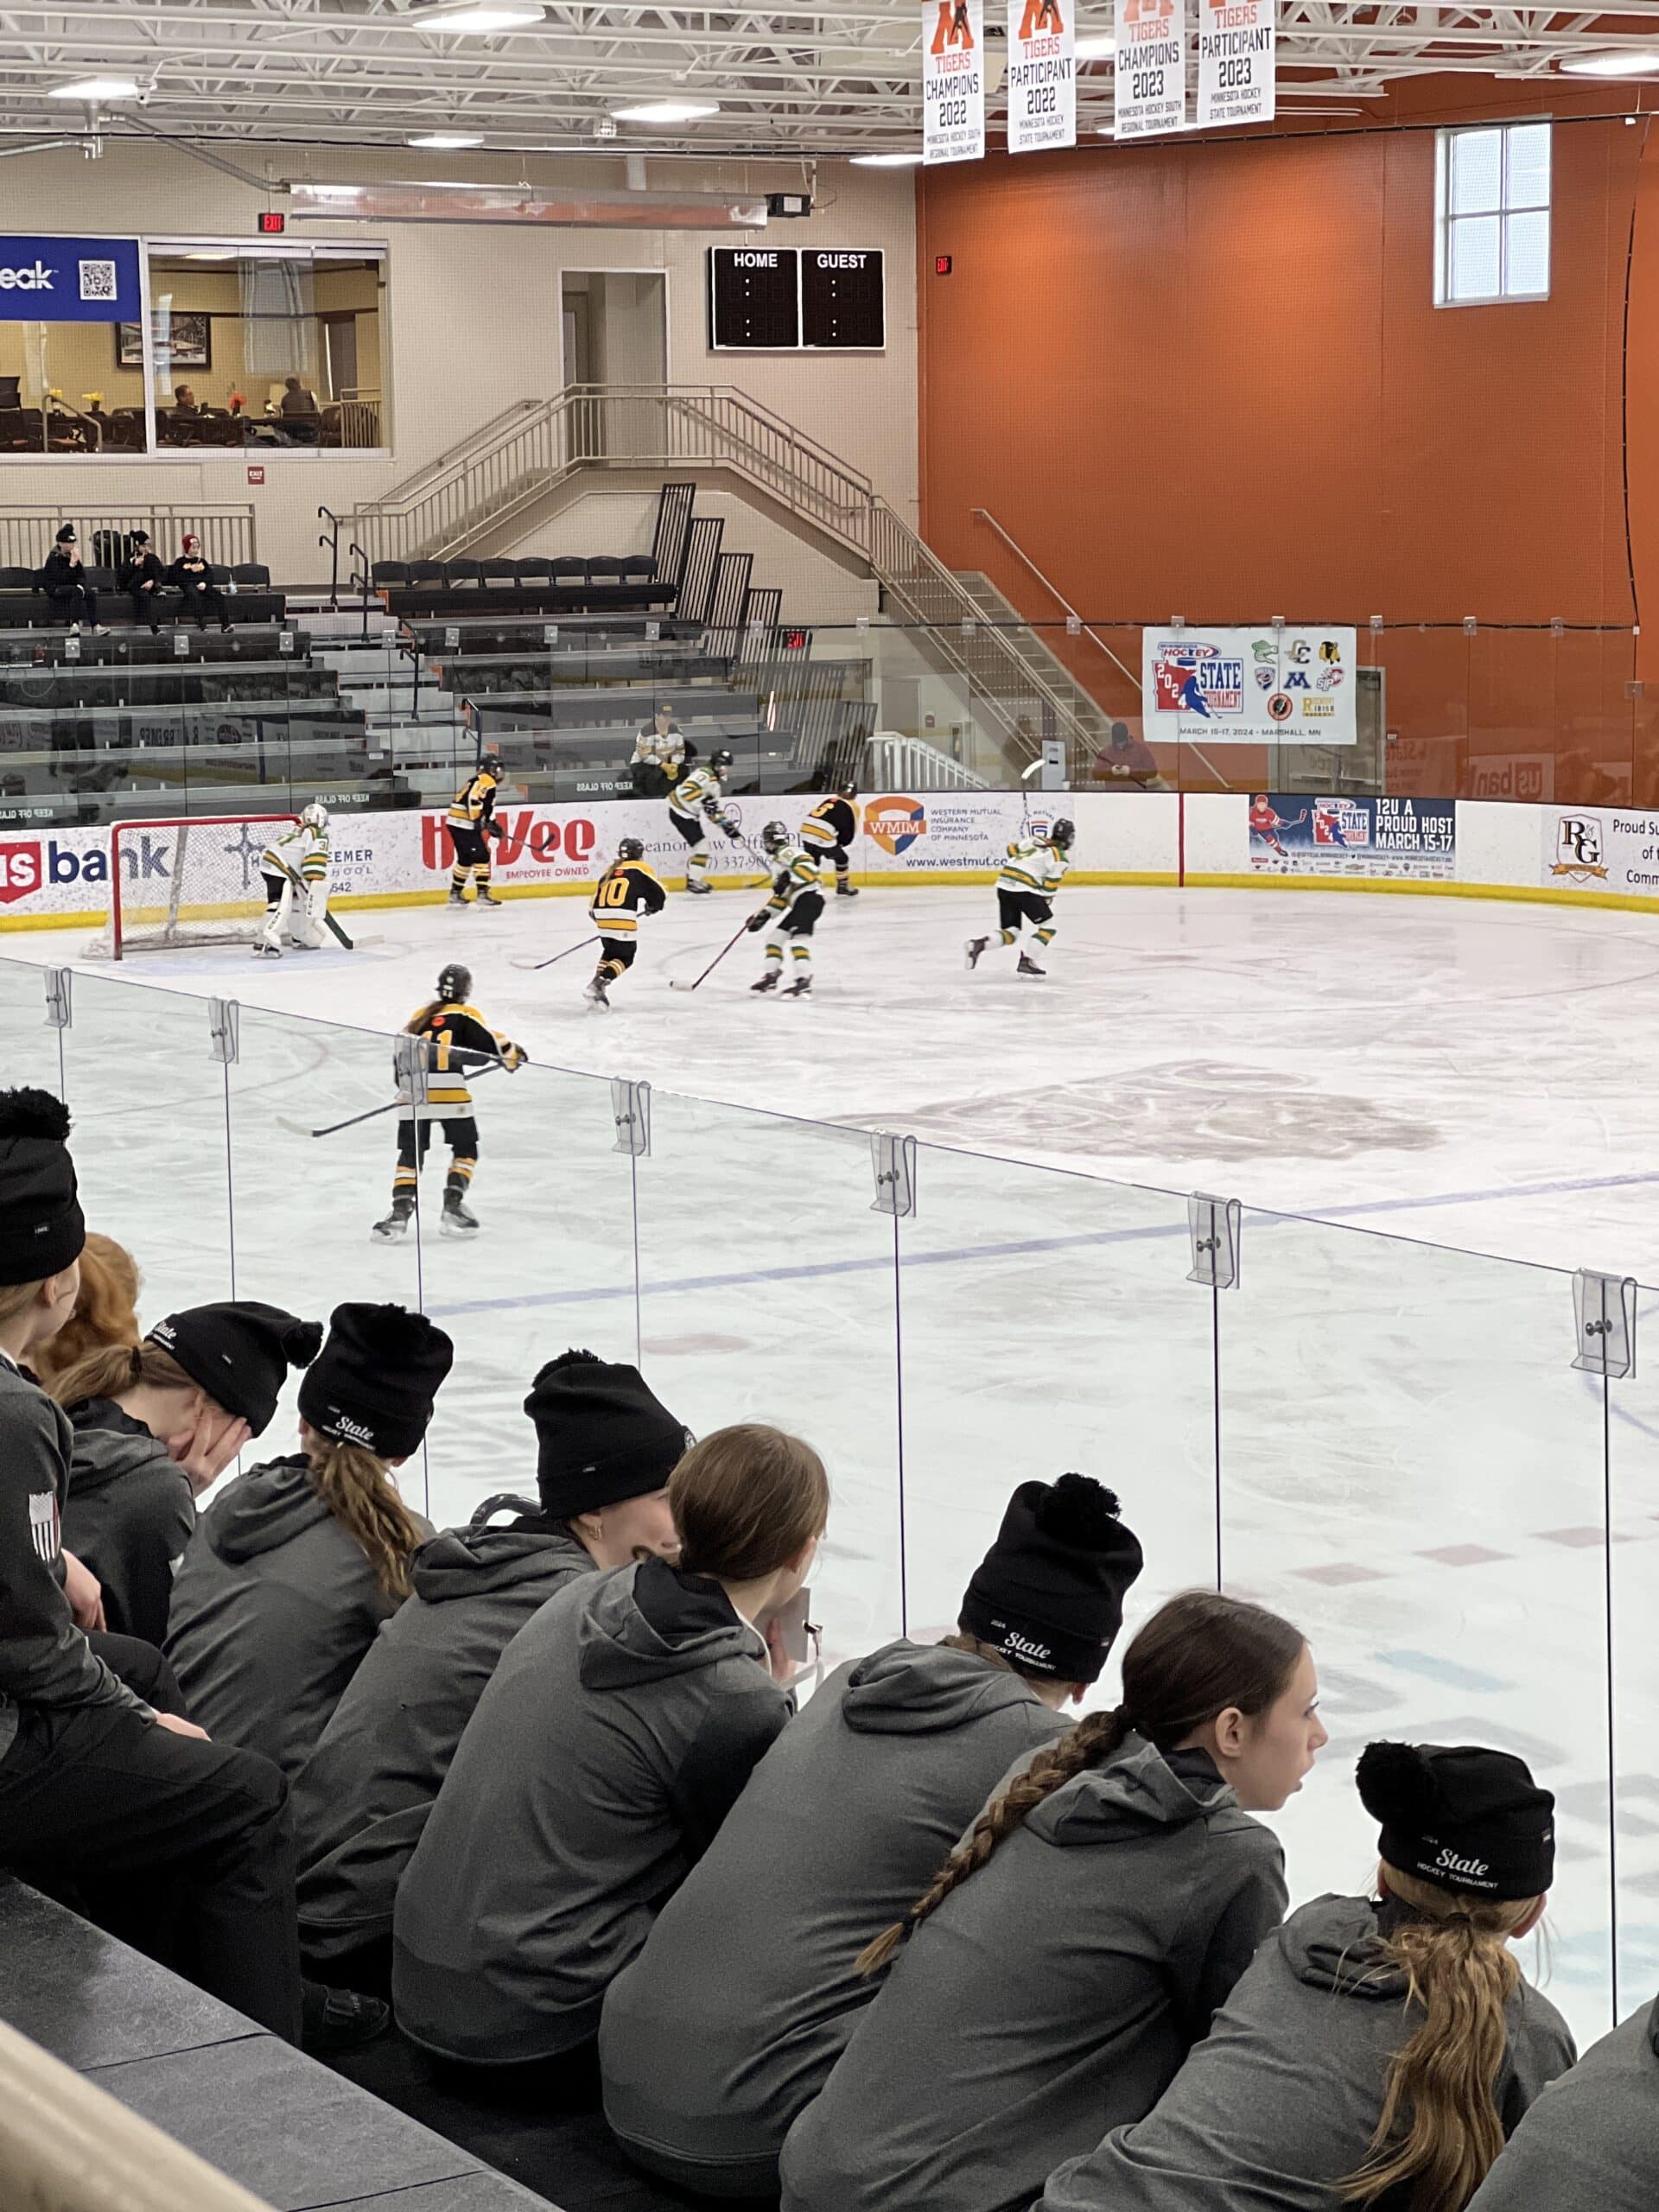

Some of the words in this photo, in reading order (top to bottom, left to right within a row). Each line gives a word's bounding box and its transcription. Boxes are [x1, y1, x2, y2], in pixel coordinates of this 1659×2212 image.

[1214, 4, 1257, 29] TIGERS
[1128, 18, 1169, 42] TIGERS
[1023, 36, 1060, 60] TIGERS
[1202, 28, 1271, 59] PARTICIPANT
[935, 52, 970, 73] TIGERS
[1119, 41, 1179, 71] CHAMPIONS
[1011, 58, 1071, 88] PARTICIPANT
[1133, 69, 1164, 99] 2023
[1218, 57, 1251, 88] 2023
[926, 73, 978, 100] CHAMPIONS
[1211, 90, 1239, 104] MINNESOTA
[1241, 87, 1262, 99] HOCKEY
[1027, 86, 1055, 114] 2022
[1118, 105, 1143, 118] MINNESOTA
[1145, 102, 1164, 115] HOCKEY
[1166, 99, 1182, 112] SOUTH
[1210, 107, 1225, 119] STATE
[1227, 103, 1262, 118] TOURNAMENT
[939, 99, 967, 127] 2022
[734, 253, 778, 267] HOME
[817, 254, 867, 268] GUEST
[1200, 663, 1241, 689] STATE
[1376, 798, 1399, 815] 12U
[1404, 799, 1414, 815] A
[870, 822, 919, 834] WMIM
[1342, 812, 1367, 830] STATE
[1376, 816, 1417, 832] PROUD
[1421, 817, 1453, 834] HOST
[1613, 819, 1645, 835] Proud
[1376, 832, 1420, 850] MARCH
[1423, 835, 1453, 851] 15-17
[1643, 846, 1654, 860] of
[48, 836, 170, 884] bank
[505, 868, 551, 880] EMPLOYEE
[555, 867, 589, 877] OWNED
[599, 877, 630, 906] 10
[335, 1416, 374, 1440] State
[1004, 1631, 1051, 1659] State
[1436, 1848, 1489, 1876] State
[1417, 1861, 1446, 1878] HOCKEY
[1449, 1872, 1499, 1889] TOURNAMENT
